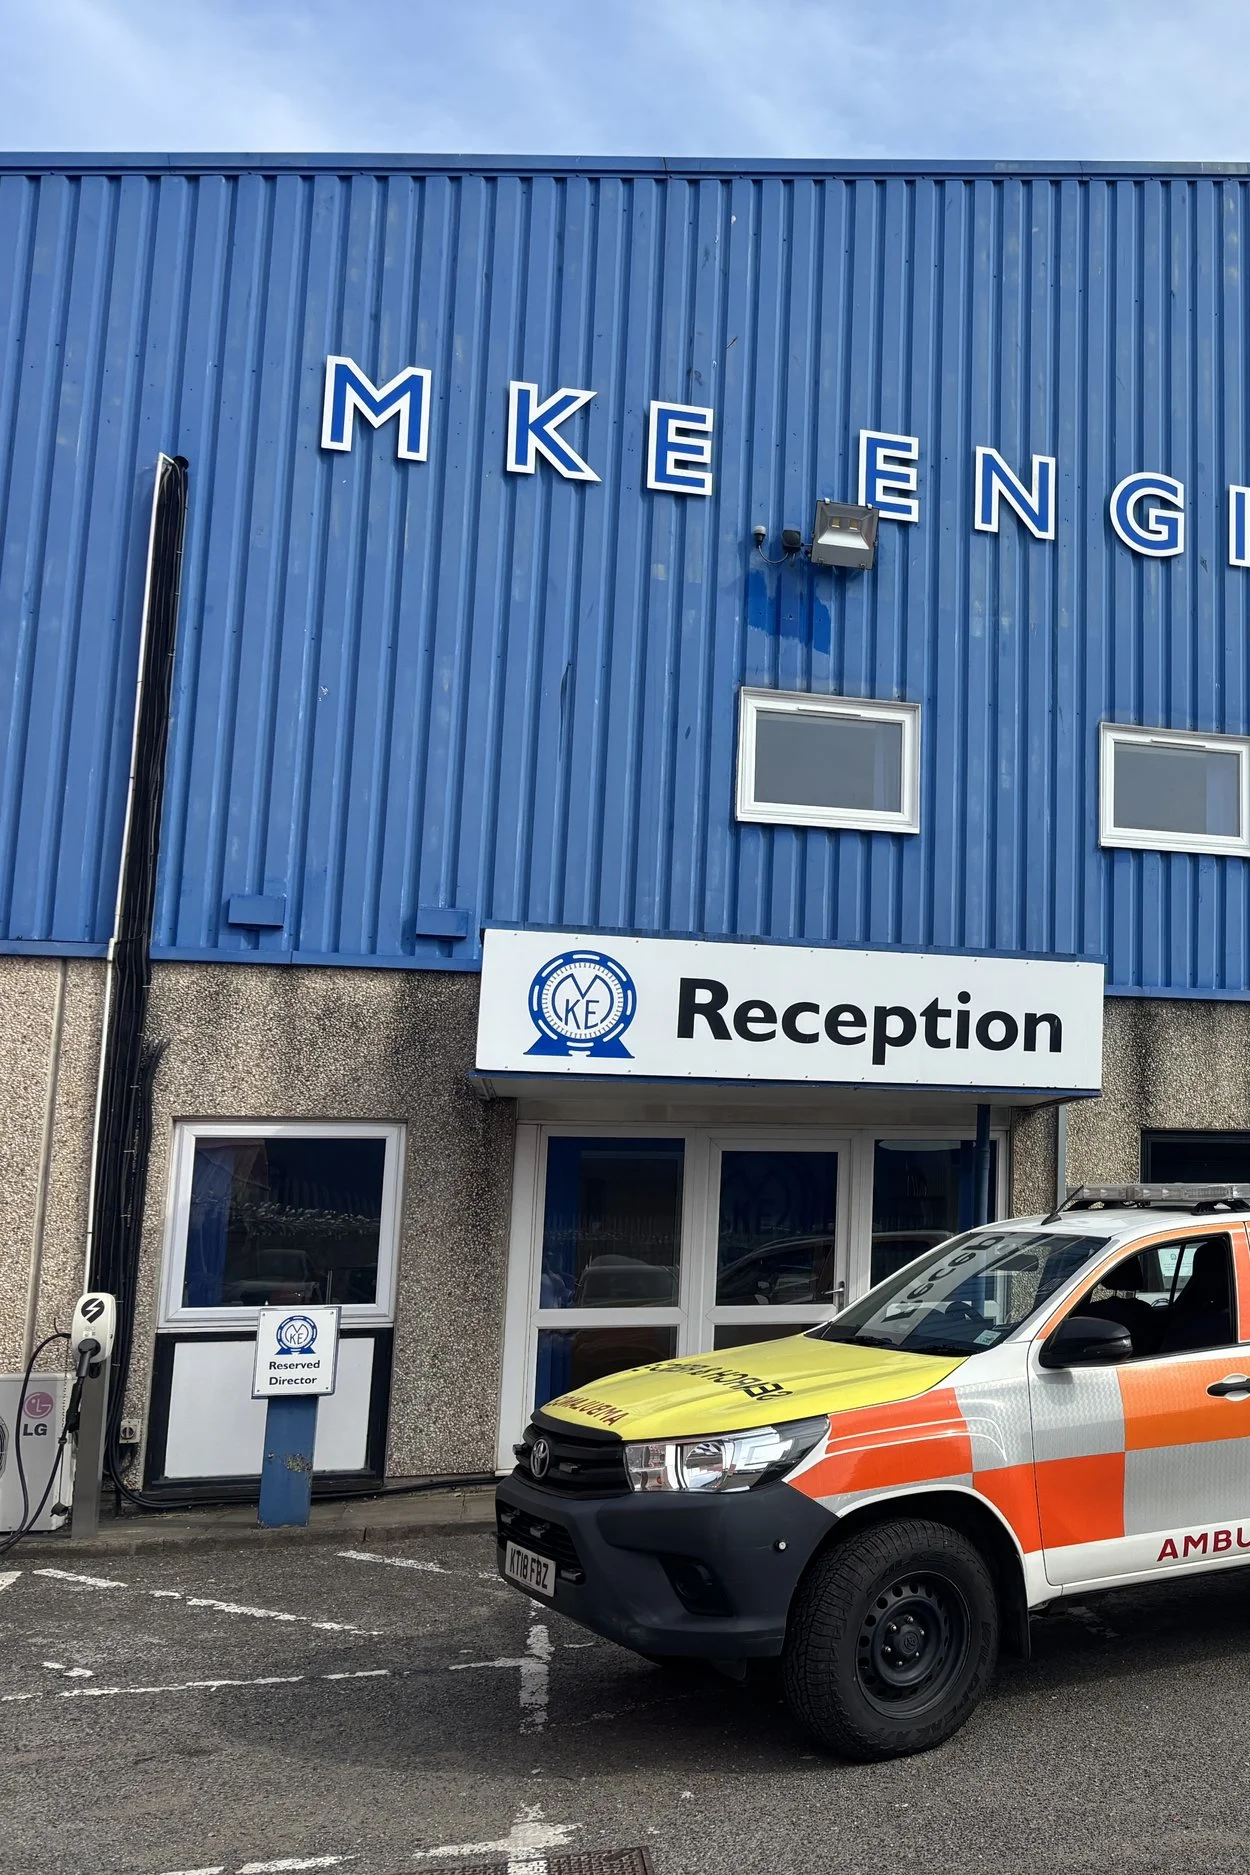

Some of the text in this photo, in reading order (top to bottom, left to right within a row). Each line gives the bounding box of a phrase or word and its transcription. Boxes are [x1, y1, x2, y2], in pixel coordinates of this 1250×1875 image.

[321, 354, 713, 496] MKE
[677, 977, 1063, 1066] Reception
[269, 1360, 321, 1370] Reserved
[269, 1376, 318, 1386] Director
[22, 1423, 48, 1437] LG
[509, 1547, 549, 1590] KT18 FBZ
